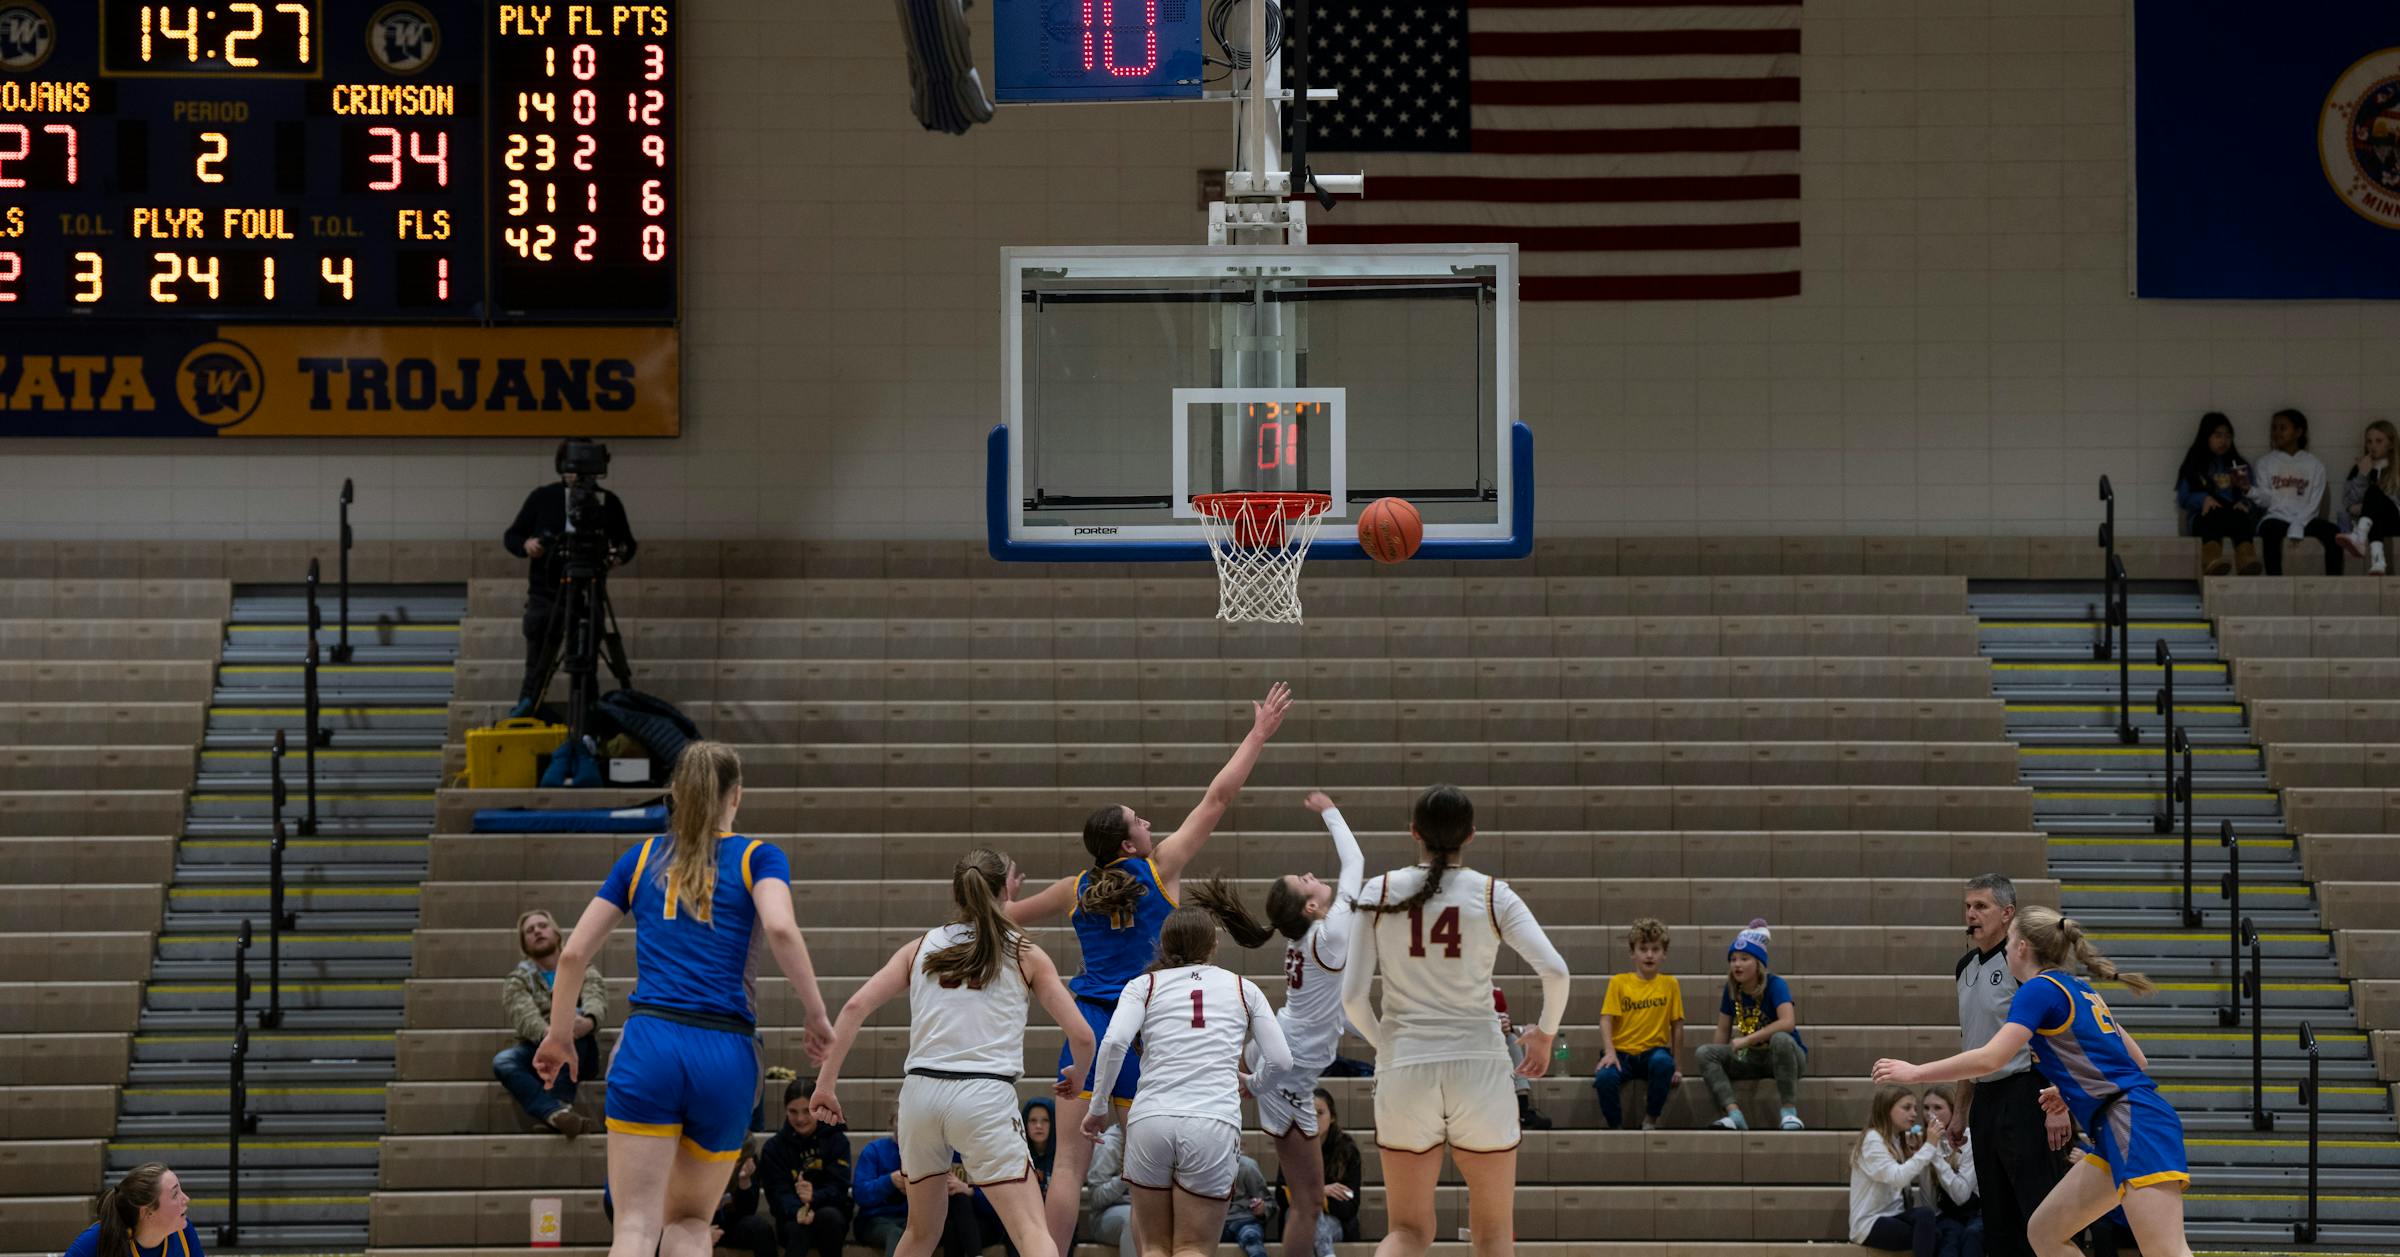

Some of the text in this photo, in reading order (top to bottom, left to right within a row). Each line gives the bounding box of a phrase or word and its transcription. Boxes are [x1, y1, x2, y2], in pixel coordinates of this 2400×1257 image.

[141, 2, 310, 68] 14:27
[499, 5, 668, 36] PLY FL PTS
[545, 44, 665, 80] 1 0 3
[0, 81, 91, 113] OJANS
[173, 102, 249, 122] PERIOD
[332, 84, 454, 116] CRIMSON
[518, 89, 665, 124] 14 0 12
[0, 123, 78, 188] 27
[196, 132, 228, 183] 2
[368, 126, 448, 191] 34
[504, 134, 665, 171] 23 2 9
[508, 178, 665, 216] 31 1 6
[59, 214, 113, 236] T.O.L.
[133, 207, 295, 240] PLYR FOUL
[310, 216, 365, 237] T.O.L.
[398, 209, 451, 240] FLS
[504, 225, 666, 261] 42 2 0
[74, 251, 103, 303] 3
[149, 252, 275, 303] 24 1
[321, 257, 354, 301] 4
[438, 257, 449, 301] 1
[0, 354, 157, 412] ATA
[297, 357, 637, 412] TROJANS
[1408, 905, 1462, 959] 14
[1190, 989, 1206, 1029] 1
